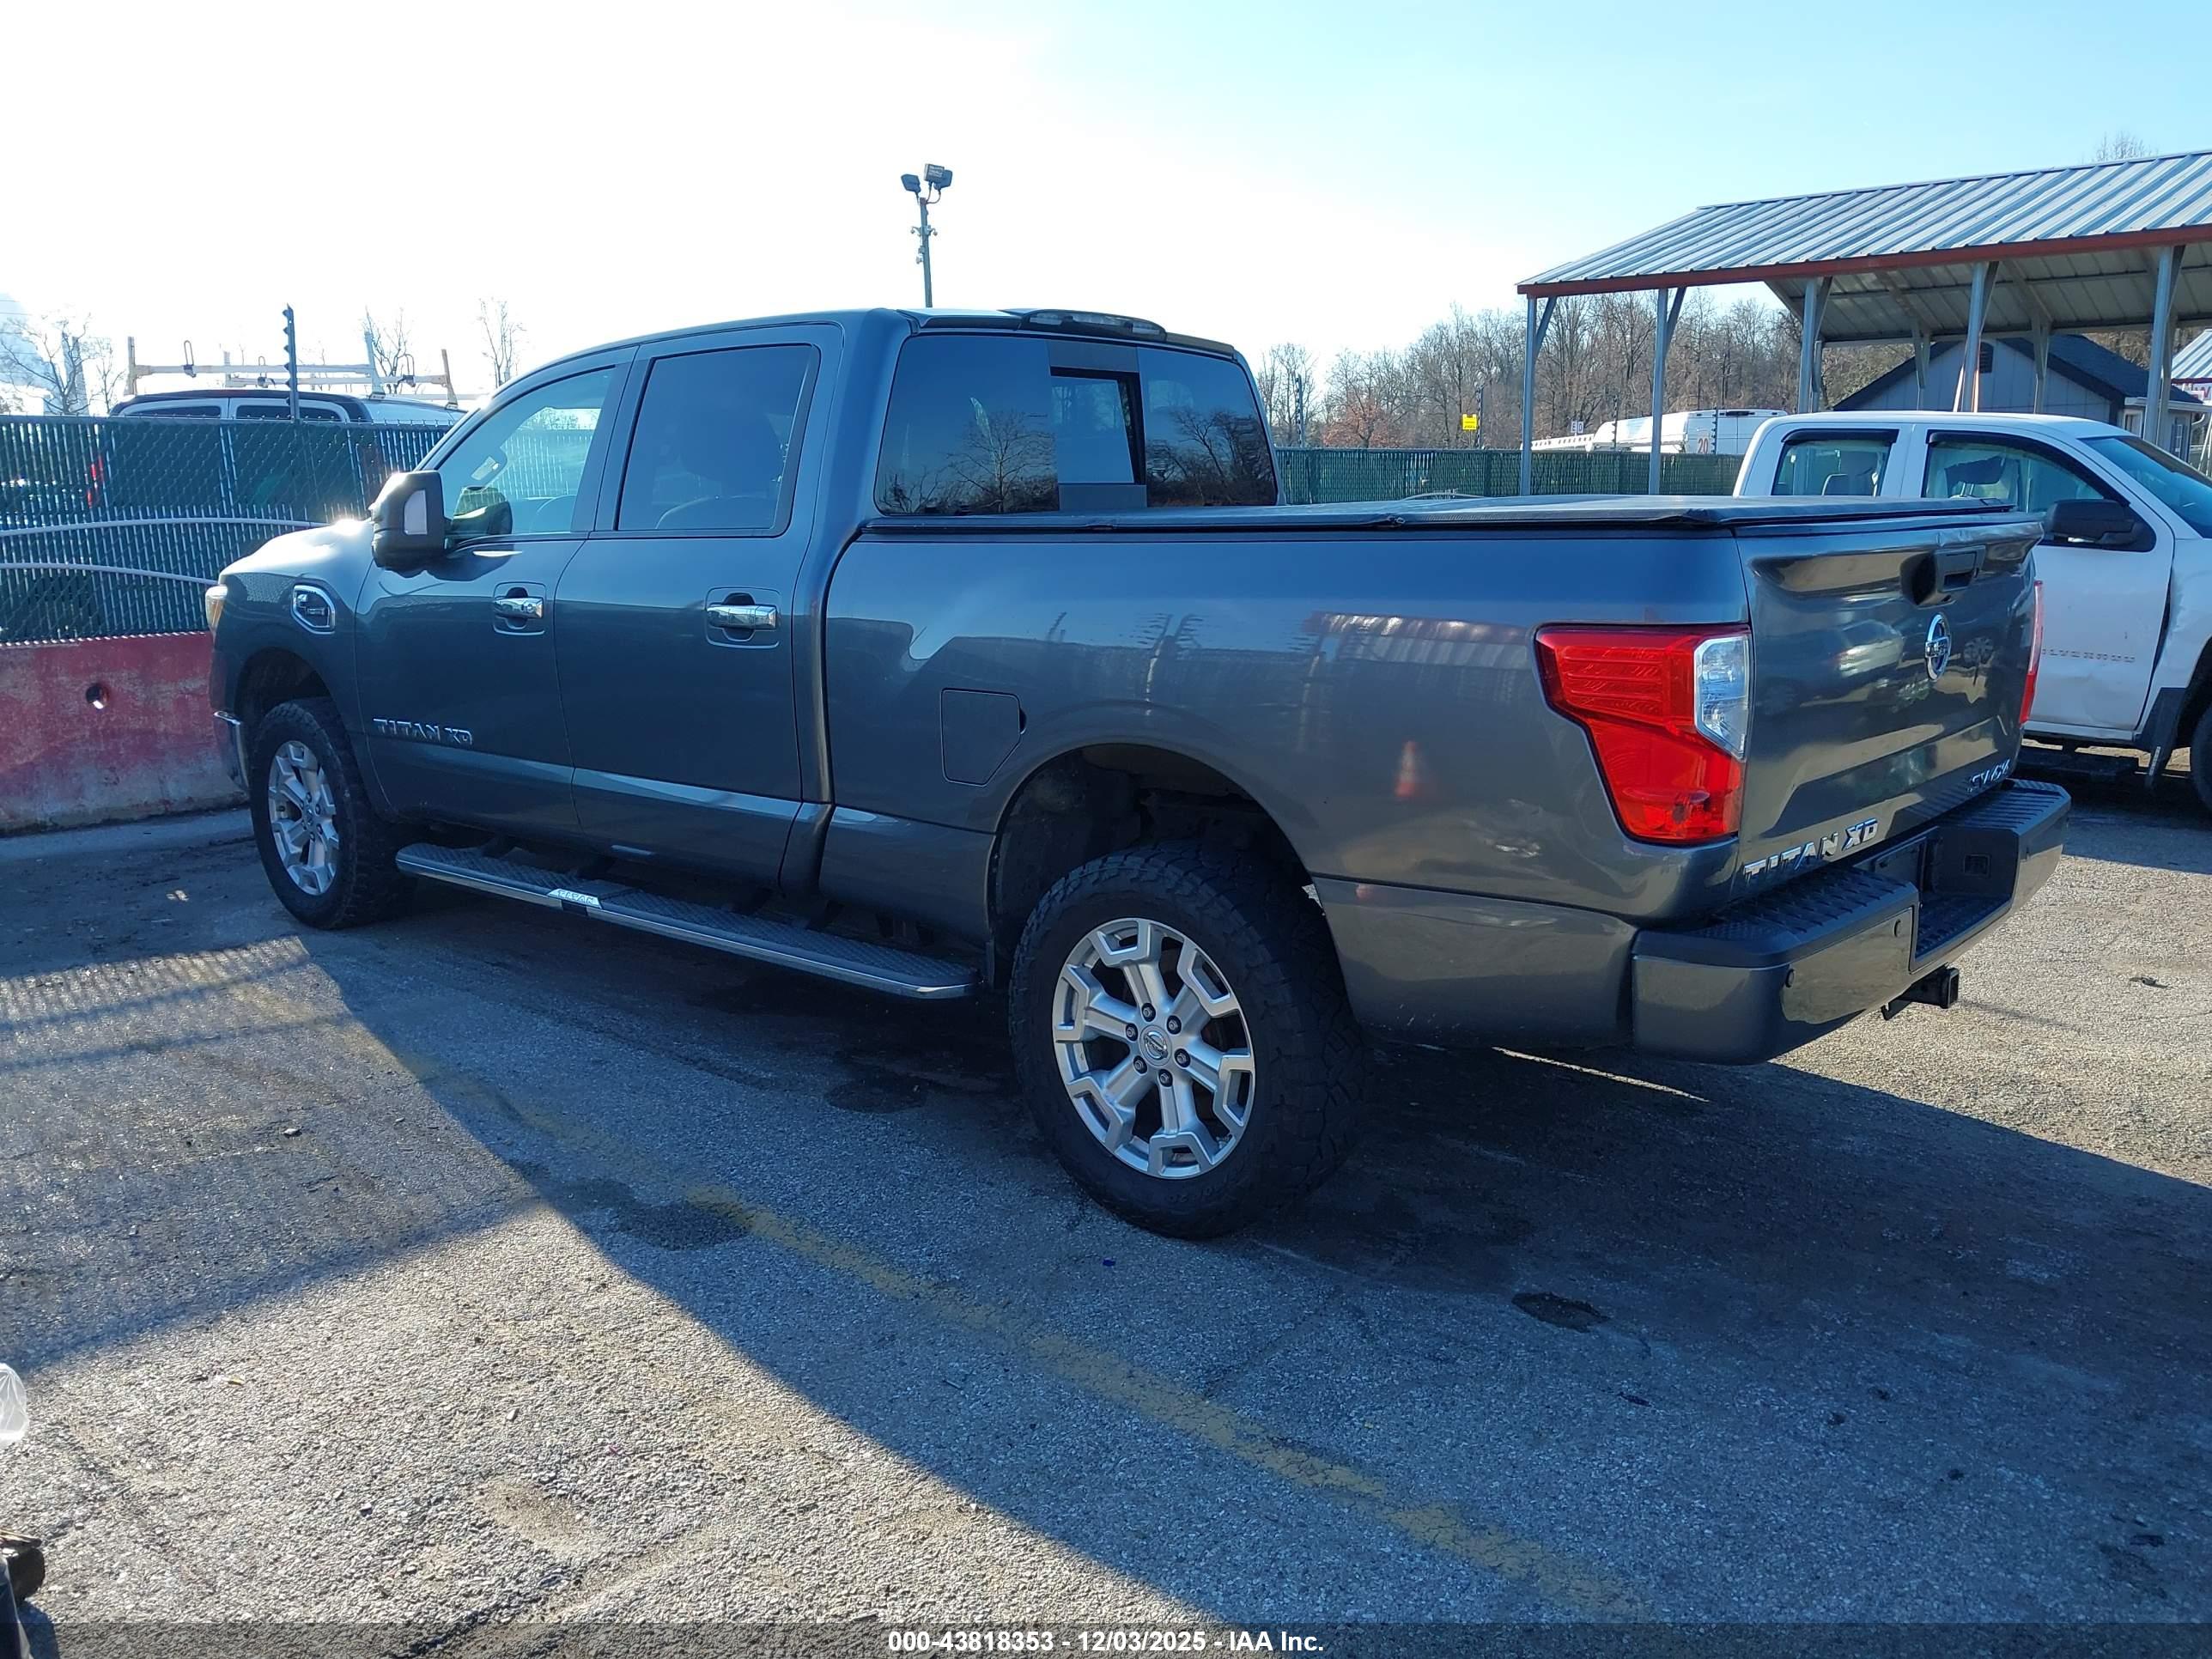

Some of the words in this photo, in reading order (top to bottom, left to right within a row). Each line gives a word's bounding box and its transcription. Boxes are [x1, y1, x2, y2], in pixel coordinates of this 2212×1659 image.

[372, 718, 441, 741] TITAN
[1743, 831, 1839, 885] TITAN
[1841, 817, 1880, 852] XD
